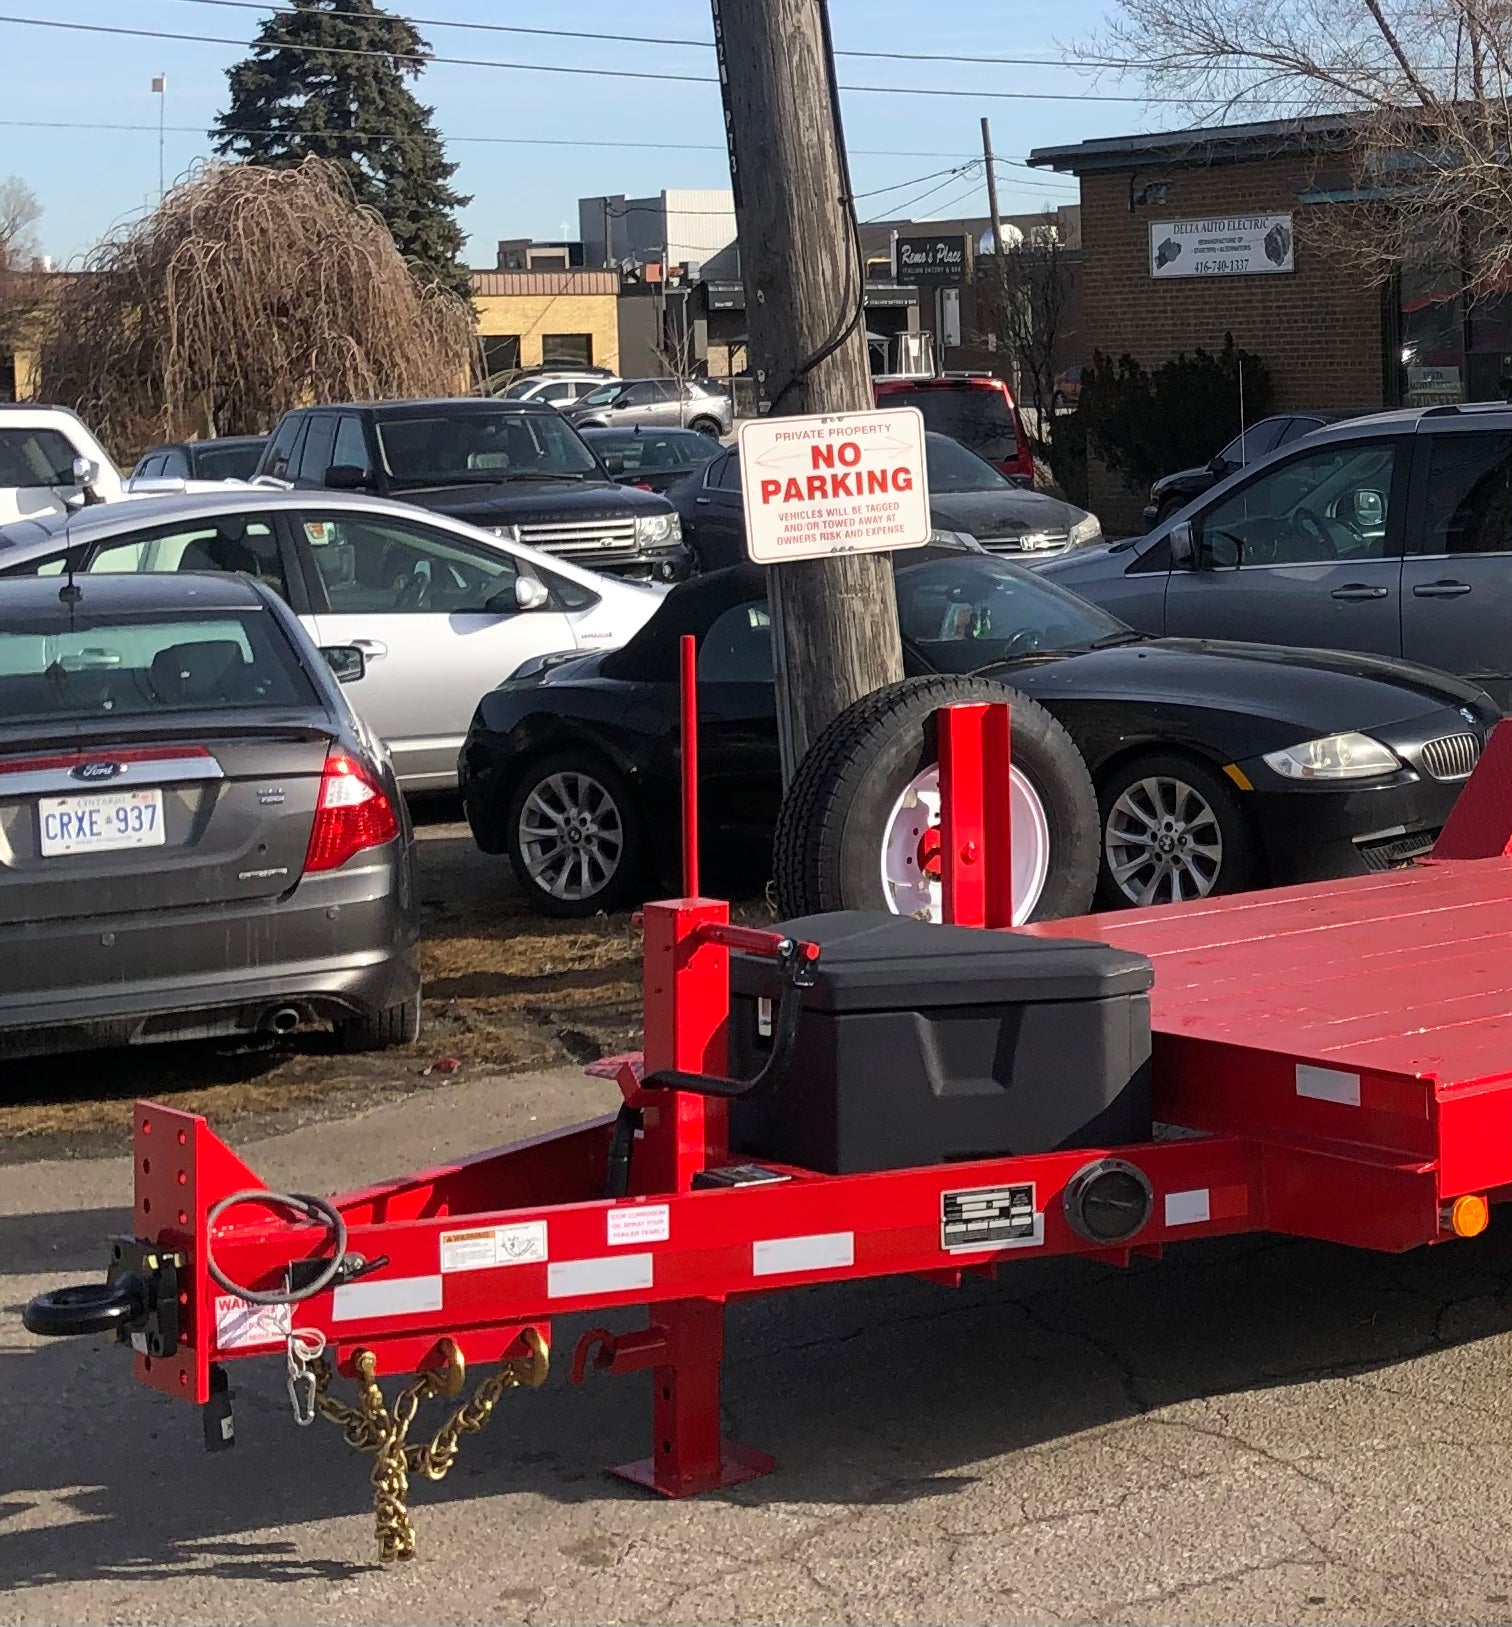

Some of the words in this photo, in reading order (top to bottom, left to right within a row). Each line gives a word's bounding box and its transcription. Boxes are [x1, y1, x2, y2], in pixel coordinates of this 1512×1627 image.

[1173, 223, 1199, 235] DELTA
[1202, 221, 1225, 233] AUTO
[1227, 218, 1269, 231] ELECTRIC
[901, 244, 934, 265] Remo's
[936, 243, 961, 265] Place
[1195, 259, 1249, 273] 416-740-1337
[775, 428, 825, 442] PRIVATE
[828, 423, 892, 438] PROPERTY
[811, 442, 862, 470] NO
[761, 466, 913, 505] PARKING
[778, 509, 823, 522] VEHICLES
[826, 506, 849, 518] WILL
[851, 504, 863, 515] BE
[865, 501, 900, 513] TAGGED
[784, 521, 820, 533] AND/OR
[821, 517, 855, 529] TOWED
[858, 515, 883, 526] AWAY
[885, 513, 897, 523] AT
[776, 532, 817, 546] OWNERS
[820, 531, 842, 542] RISK
[845, 528, 863, 539] AND
[865, 524, 905, 537] EXPENSE
[83, 765, 114, 777] Ford
[45, 809, 102, 840] CRXE
[115, 804, 157, 834] 937
